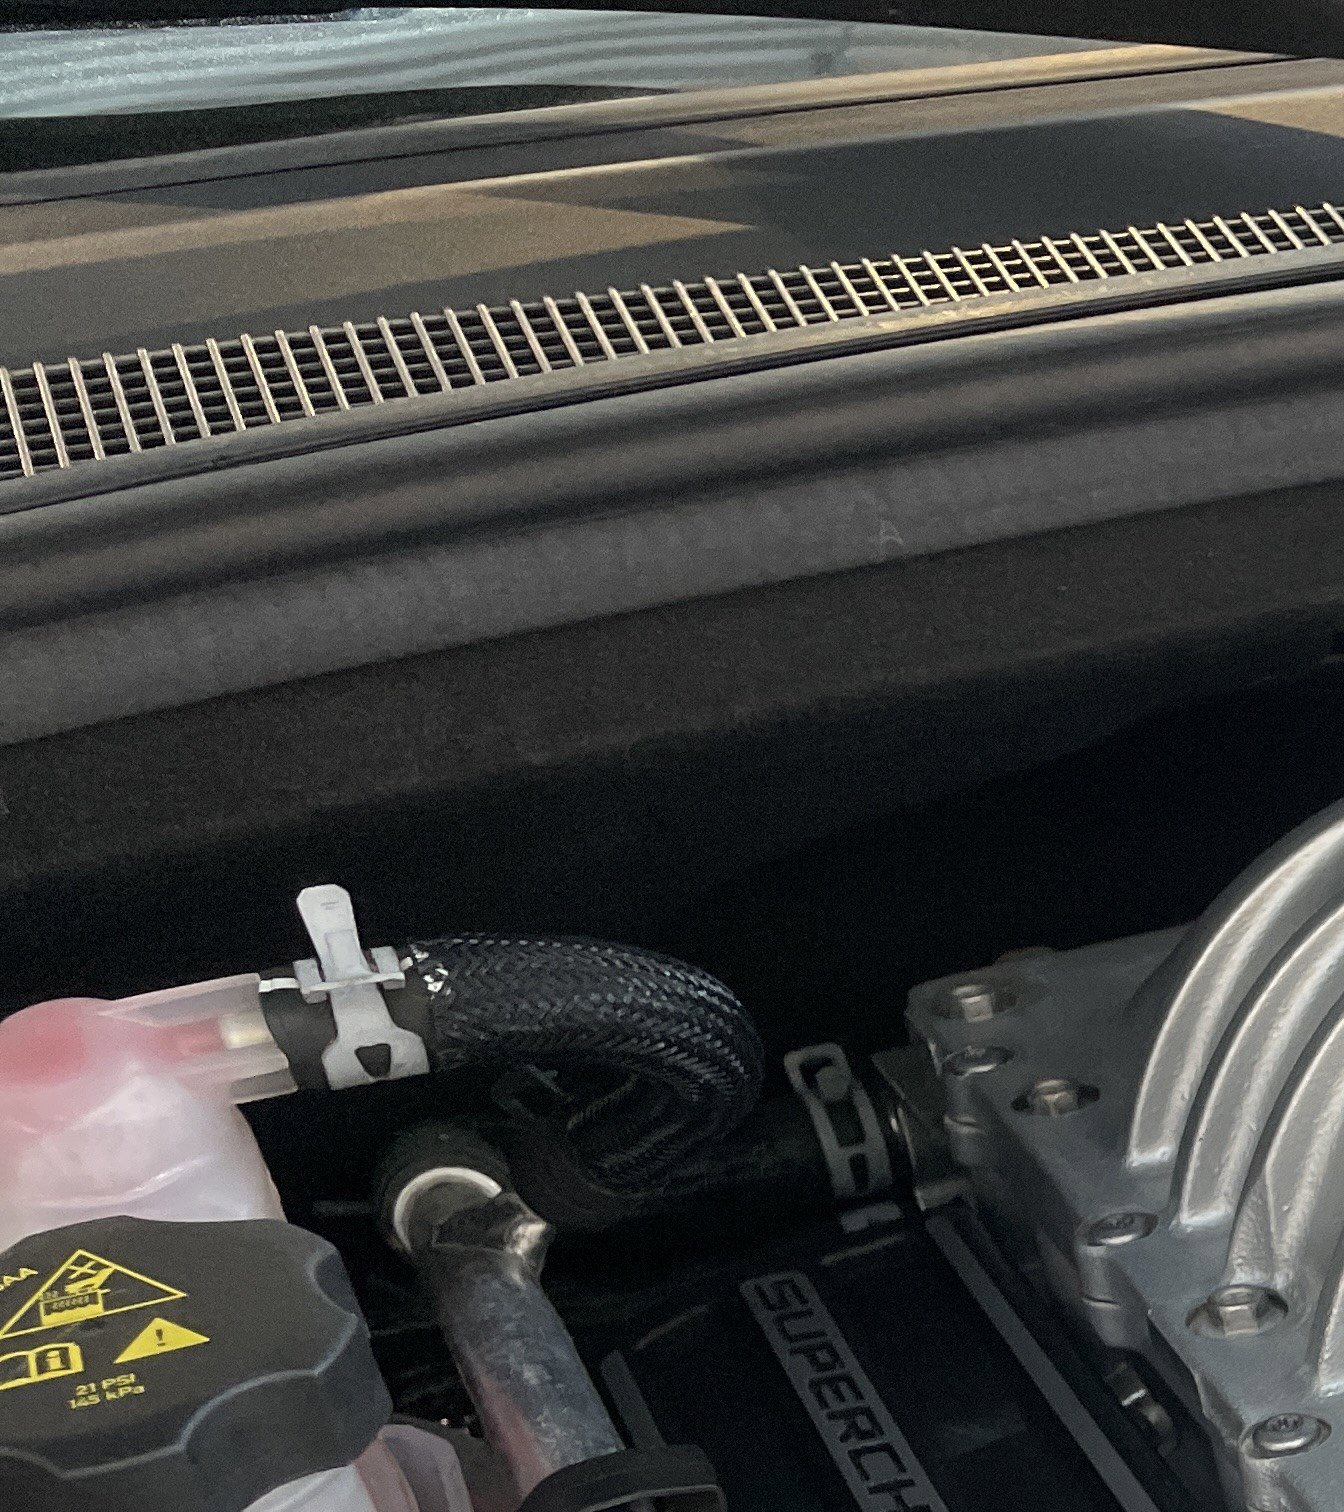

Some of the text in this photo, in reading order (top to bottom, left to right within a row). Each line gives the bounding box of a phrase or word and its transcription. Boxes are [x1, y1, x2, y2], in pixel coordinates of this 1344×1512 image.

[75, 1372, 136, 1396] 21 PSI
[105, 1385, 145, 1400] kPa
